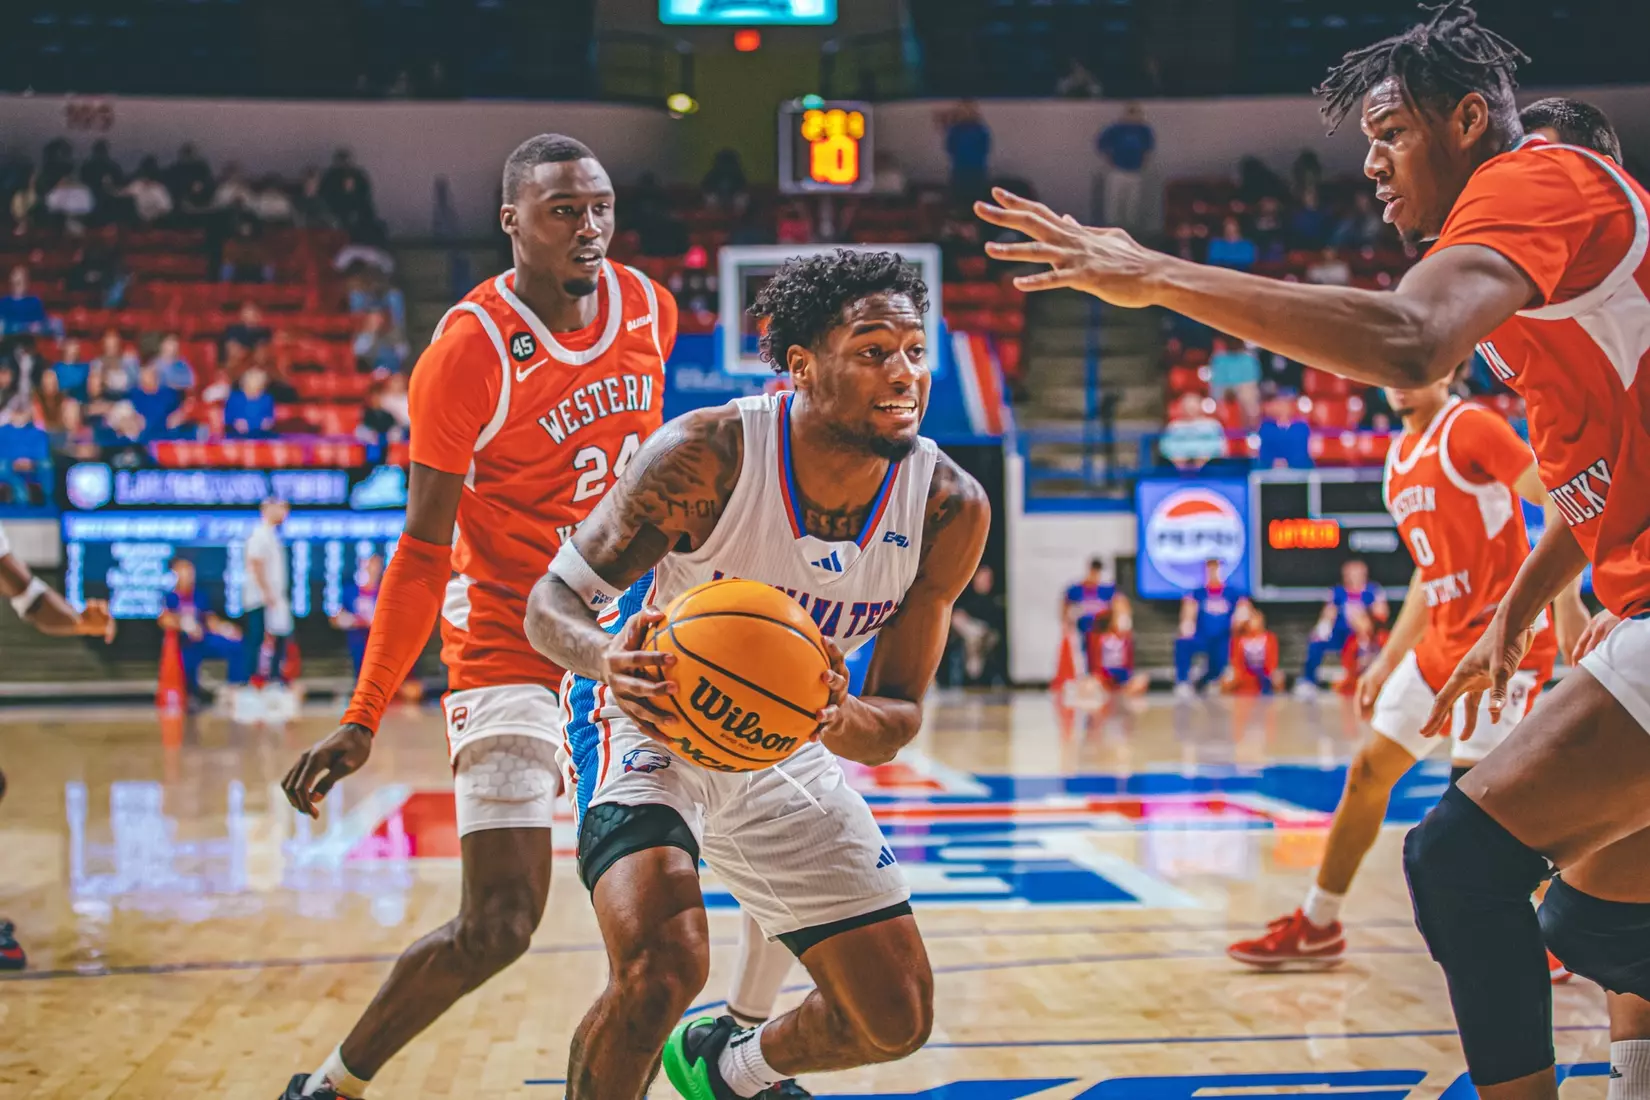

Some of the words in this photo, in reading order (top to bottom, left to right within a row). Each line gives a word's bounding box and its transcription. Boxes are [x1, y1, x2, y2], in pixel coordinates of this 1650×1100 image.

[512, 335, 534, 357] 45
[537, 374, 653, 446] WESTERN
[1409, 527, 1435, 567] 0
[690, 675, 798, 753] Wilson
